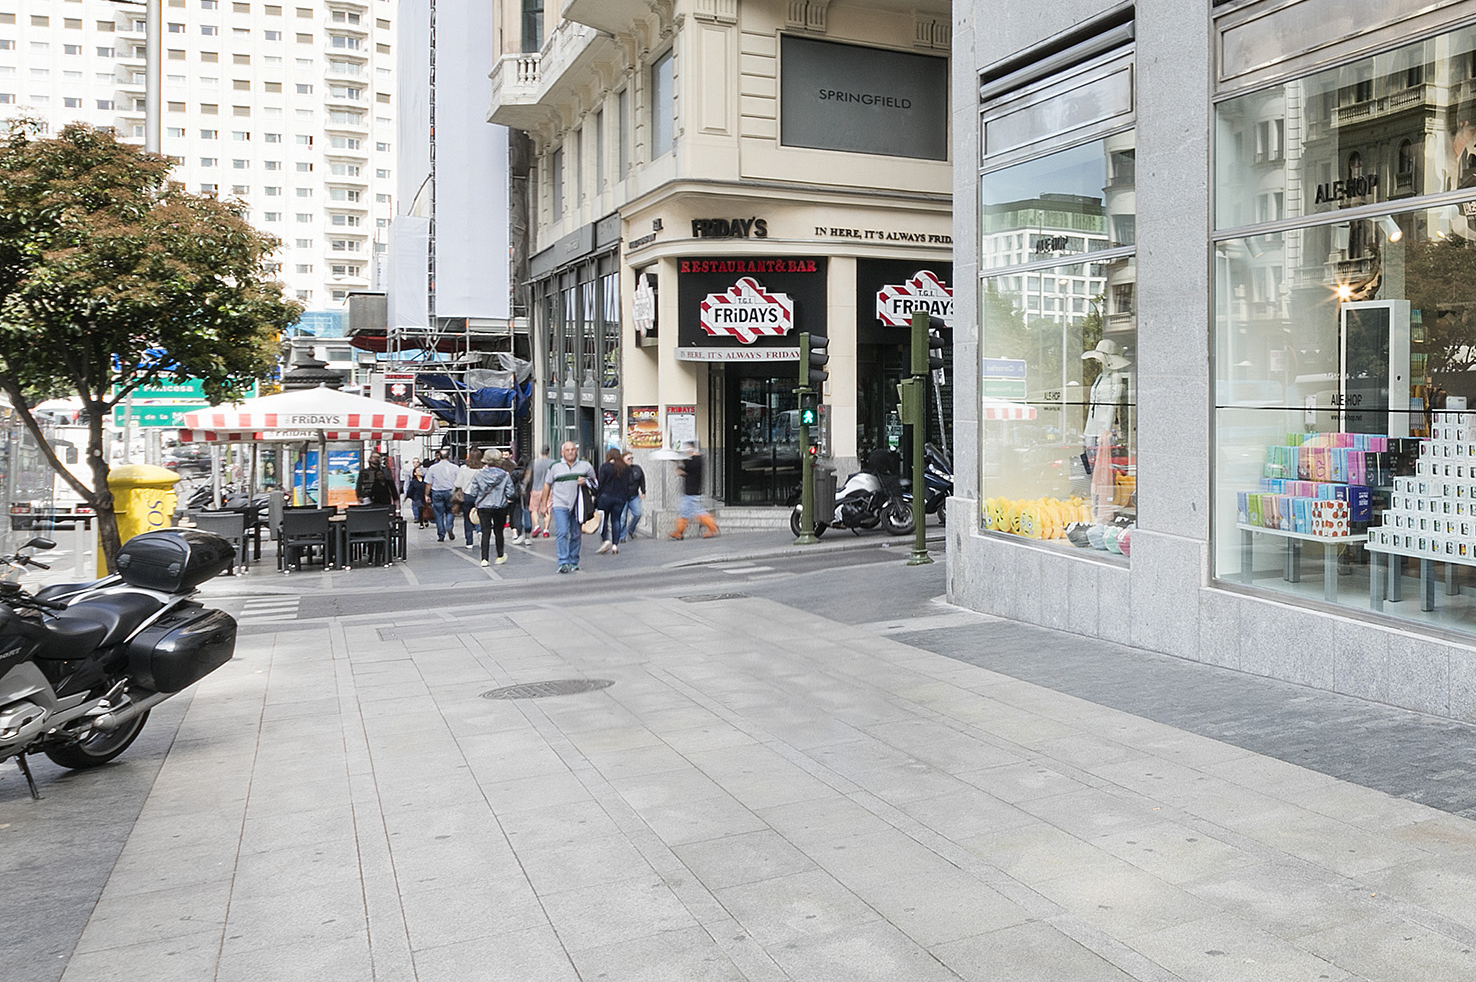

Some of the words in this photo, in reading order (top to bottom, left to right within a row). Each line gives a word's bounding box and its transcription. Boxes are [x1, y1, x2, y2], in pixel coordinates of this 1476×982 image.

[819, 88, 912, 109] SPRINGFIELD
[1314, 174, 1378, 204] ALE-HOP
[815, 226, 828, 236] IN
[830, 227, 863, 239] HERE,
[864, 230, 885, 239] IT'S
[886, 232, 927, 243] ALWAYS
[928, 234, 954, 244] FRID
[726, 351, 762, 359] ALWAYS
[1330, 394, 1362, 406] ALE-HOP
